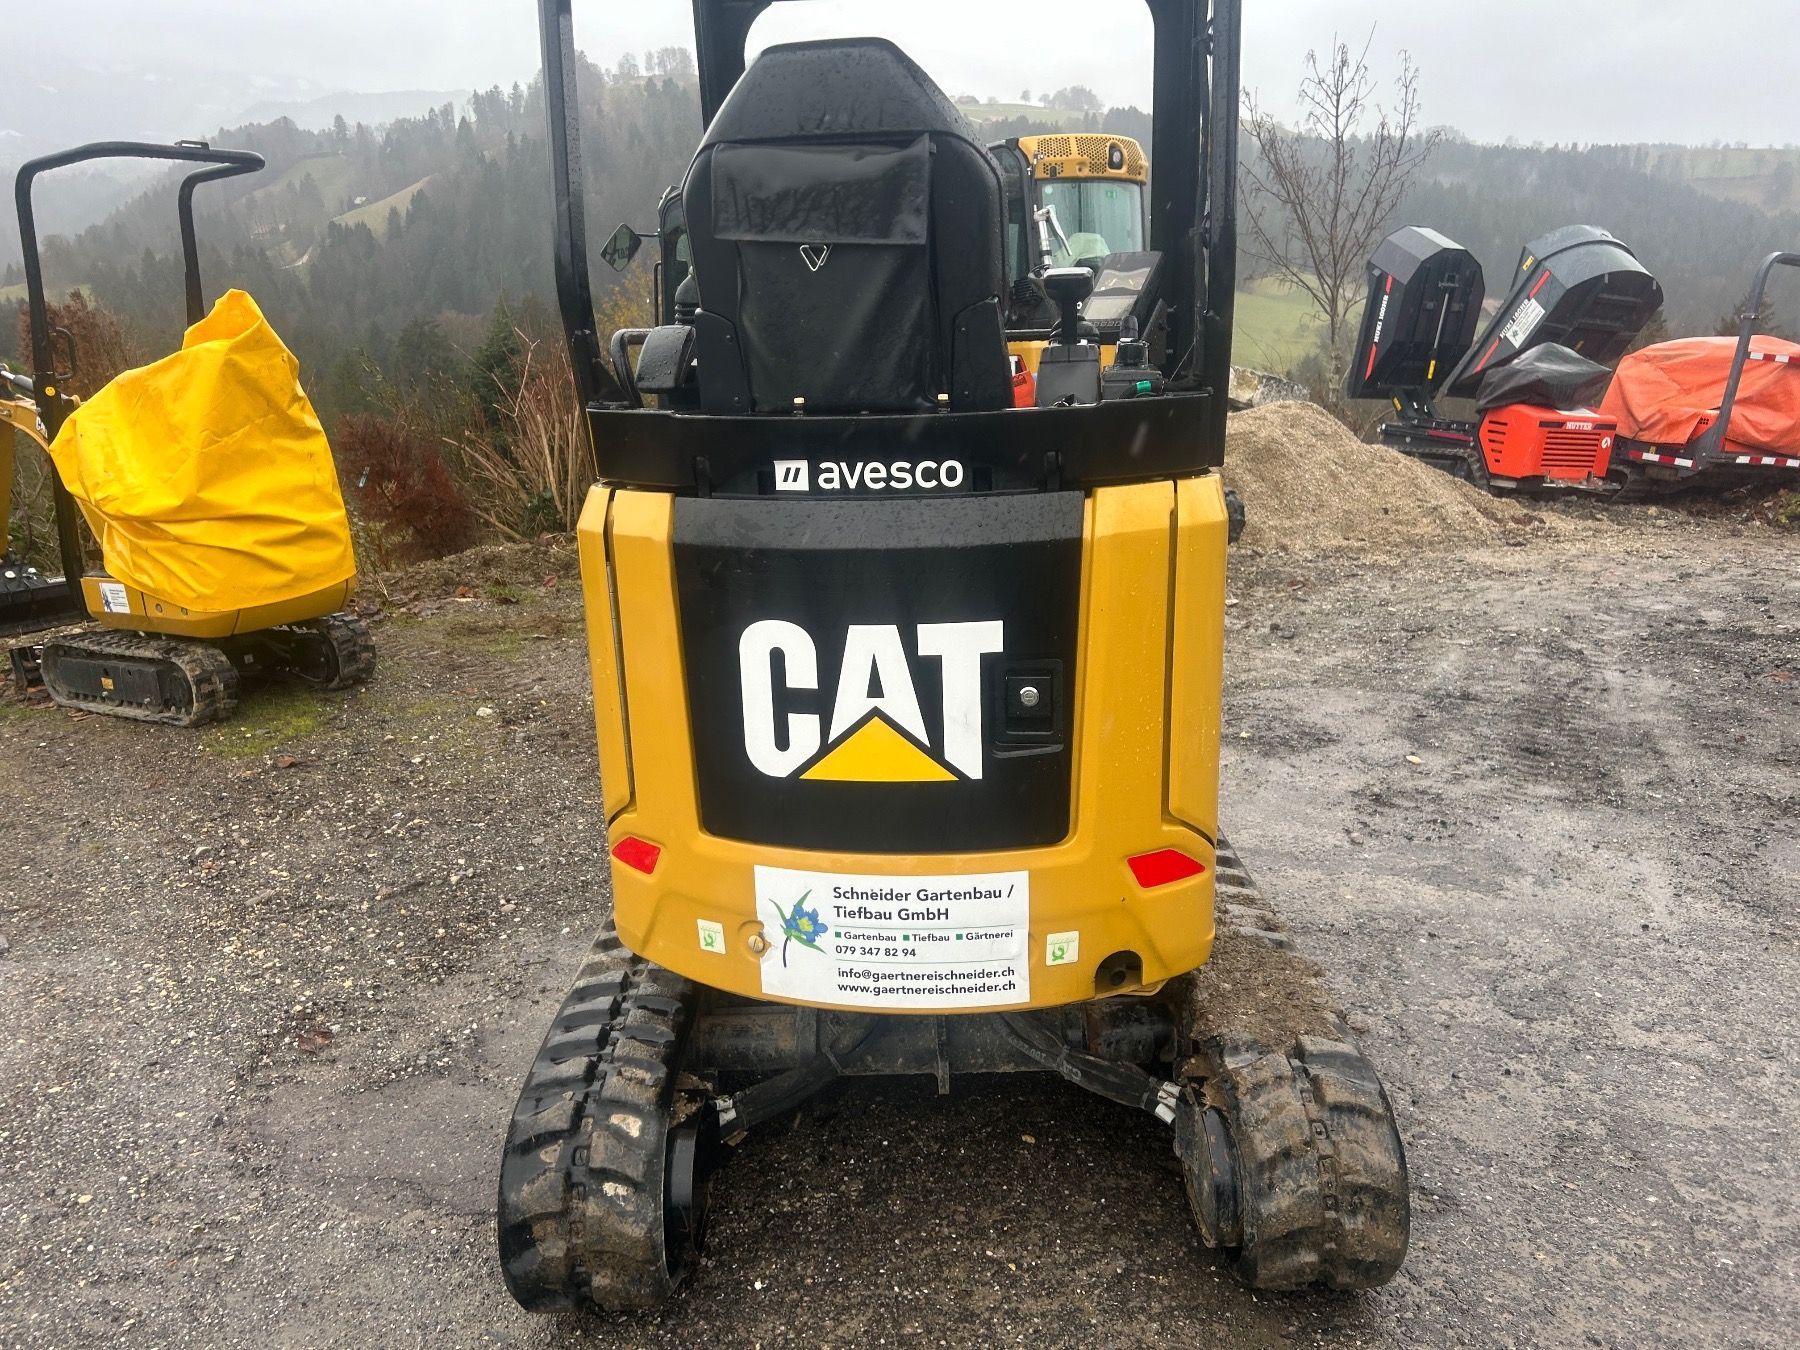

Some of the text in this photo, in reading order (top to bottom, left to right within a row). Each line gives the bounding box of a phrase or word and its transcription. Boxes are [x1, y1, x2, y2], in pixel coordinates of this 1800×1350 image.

[817, 459, 964, 490] avesco
[739, 619, 1004, 780] CAT
[833, 884, 1015, 902] Schneider Gartenbau /
[833, 905, 949, 921] Tiefbau GmbH
[843, 929, 1013, 942] Gartenbau Tiefbau Gärtnerei
[835, 945, 916, 957] 079 347 82 94
[837, 966, 1015, 982] info@gaertnereischneider.ch
[837, 980, 1016, 996] www.gaertnereischneider.ch
